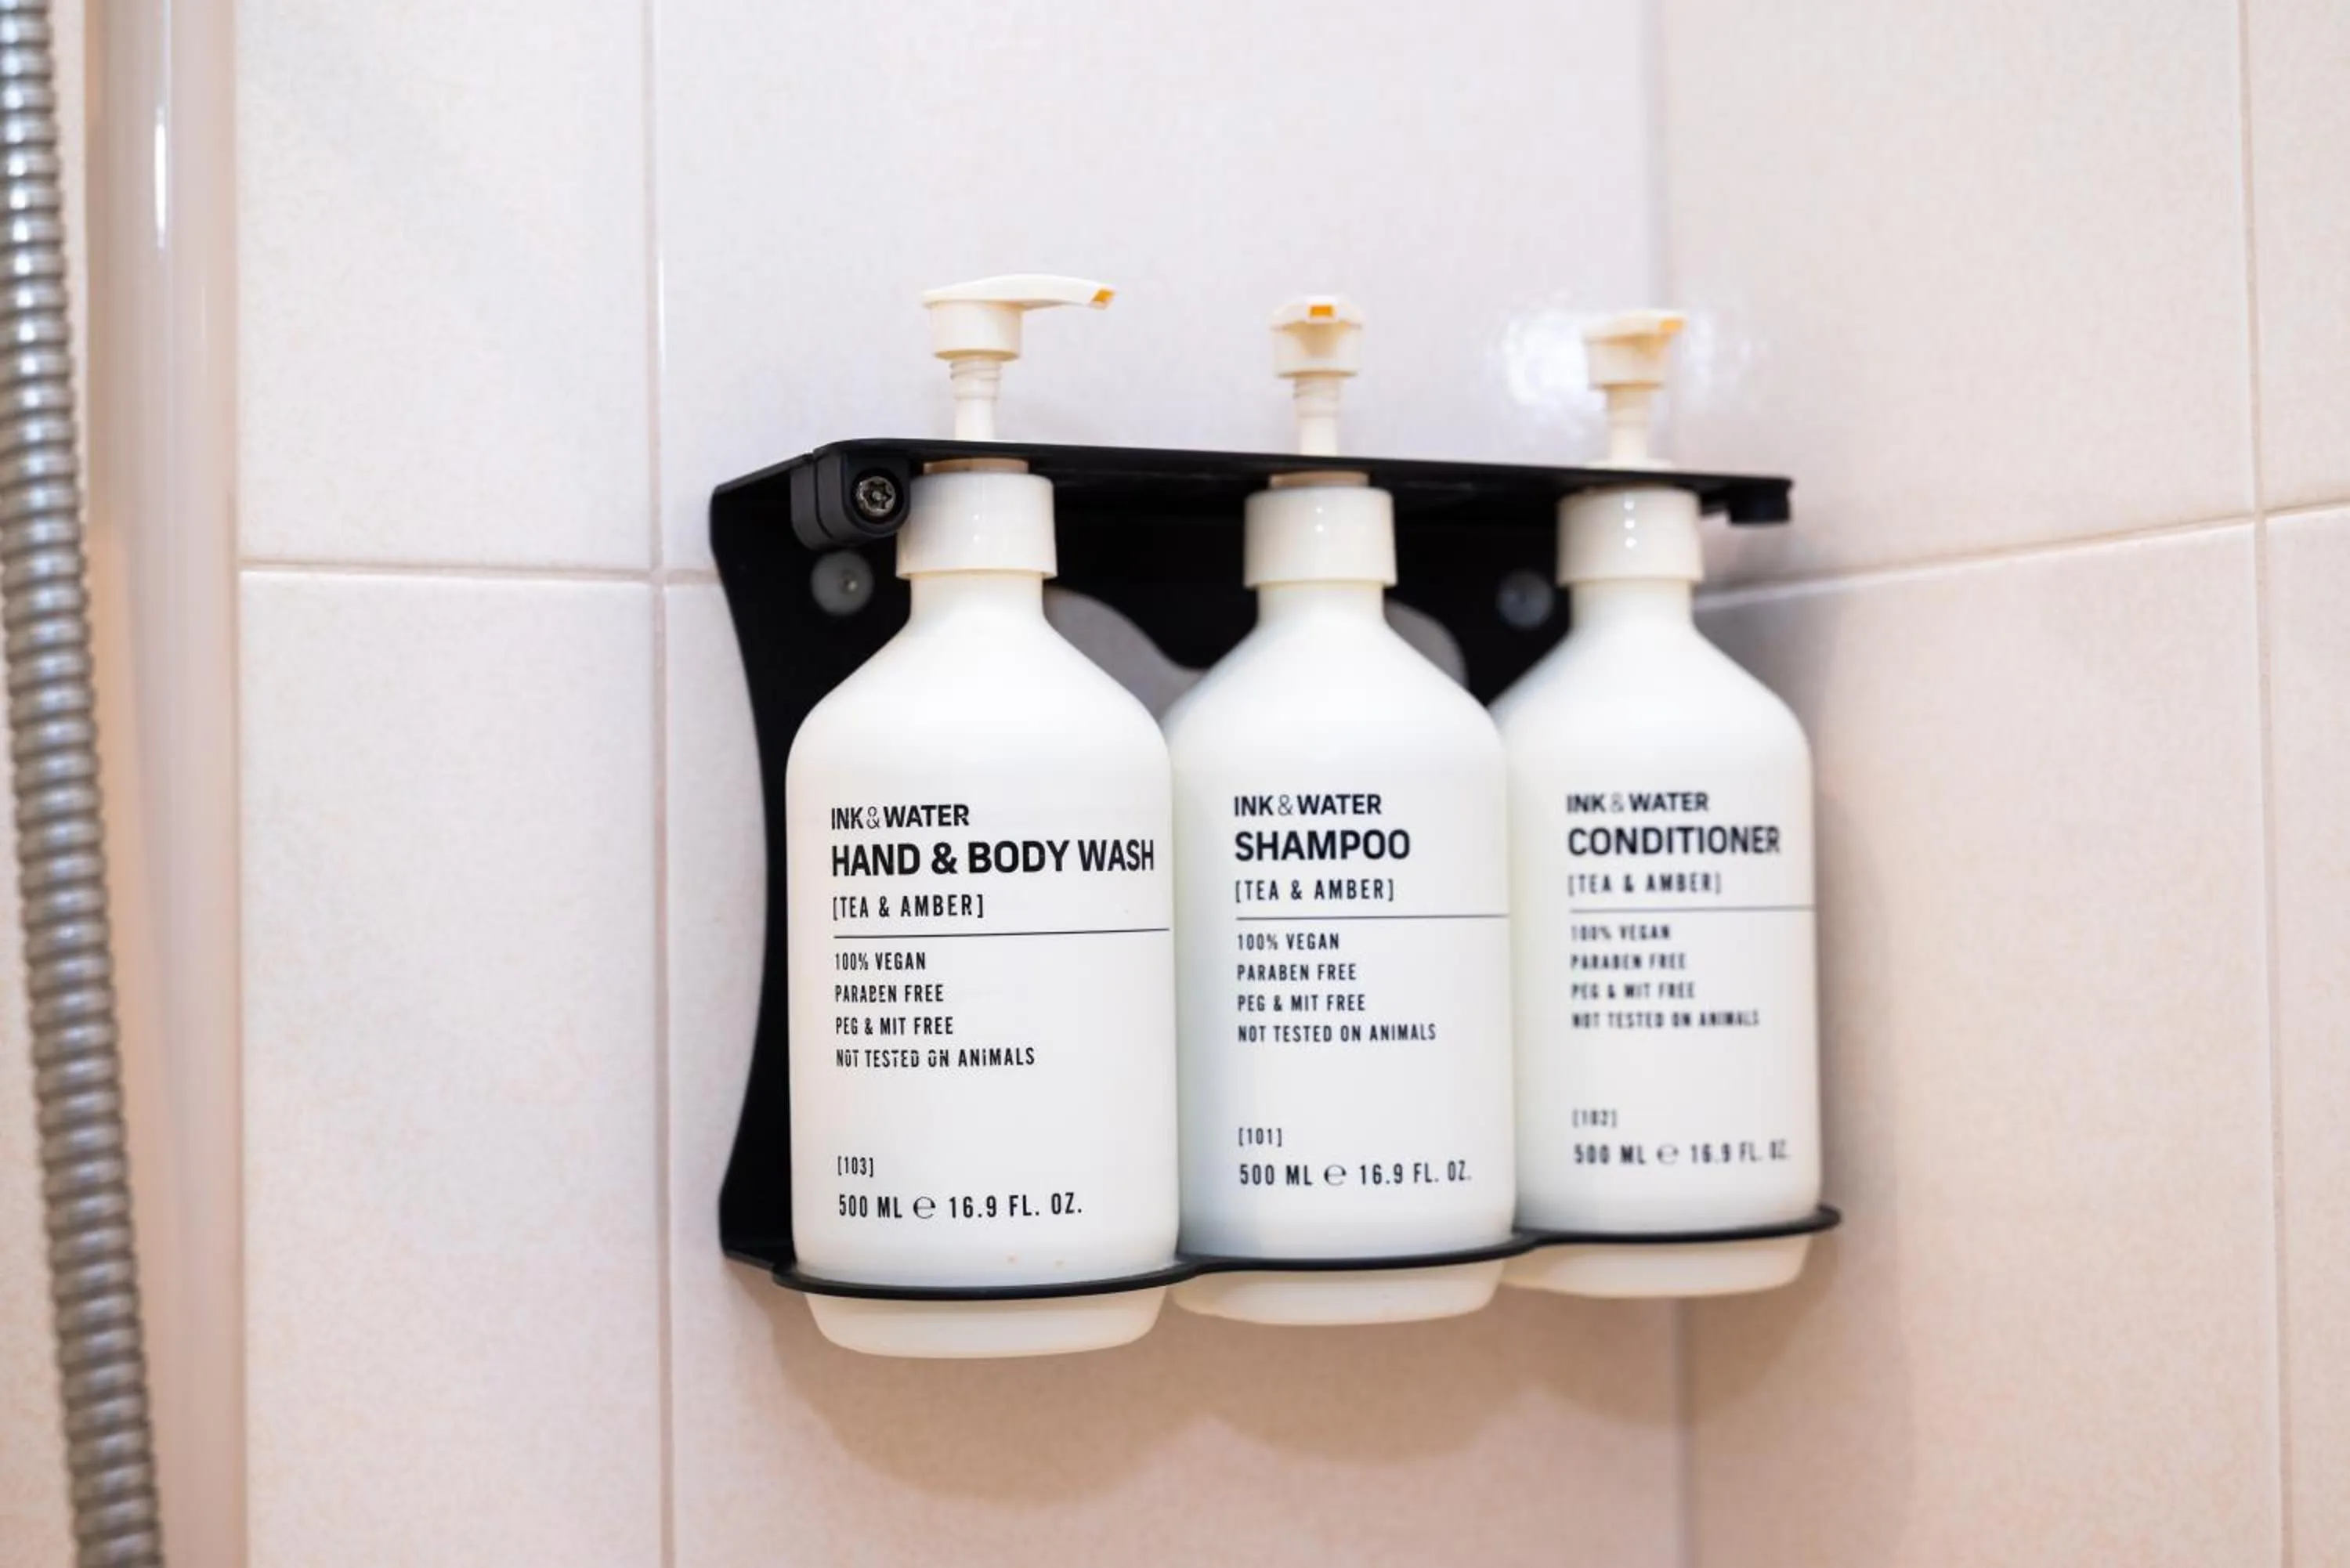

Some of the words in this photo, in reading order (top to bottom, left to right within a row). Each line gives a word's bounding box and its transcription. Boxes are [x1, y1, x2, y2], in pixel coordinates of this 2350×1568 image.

[1234, 793, 1382, 817] INK&WATER
[1566, 791, 1709, 814] INK&WATER
[831, 804, 970, 830] INK&WATER
[1235, 829, 1411, 862] SHAMPOO
[1567, 824, 1781, 857] CONDITIONER
[831, 843, 920, 877] HAND
[931, 841, 958, 875] &
[967, 839, 1070, 874] BODY
[1077, 839, 1155, 872] WASH
[1235, 880, 1279, 904] [TEA
[1290, 879, 1303, 901] &
[1314, 878, 1394, 902] AMBER]
[1567, 873, 1613, 898] [TEA
[1623, 873, 1635, 894] &
[1645, 872, 1721, 894] AMBER]
[833, 895, 870, 922] [TEA
[878, 895, 891, 918] &
[900, 894, 984, 919] AMBER]
[1237, 933, 1278, 952] 100%
[1285, 932, 1340, 951] VEGAN
[1571, 924, 1613, 942] 100%
[1619, 923, 1671, 941] VEGAN
[835, 952, 869, 971] 100%
[874, 952, 926, 971] VEGAN
[1237, 963, 1310, 981] PARABEN
[1317, 963, 1357, 981] FREE
[1570, 953, 1643, 970] PARABEN
[1648, 952, 1686, 970] FREE
[834, 985, 897, 1003] PARABEN
[904, 984, 944, 1003] FREE
[1571, 982, 1600, 1001] PEG
[1607, 983, 1617, 1000] &
[1623, 982, 1650, 999] MIT
[1658, 981, 1695, 999] FREE
[1237, 994, 1266, 1013] PEG
[1273, 994, 1283, 1012] &
[1290, 994, 1318, 1012] MIT
[1326, 993, 1365, 1012] FREE
[835, 1016, 859, 1035] PEG
[864, 1017, 873, 1036] &
[880, 1017, 906, 1035] MIT
[913, 1016, 953, 1035] FREE
[1571, 1011, 1600, 1029] NOT
[1607, 1010, 1665, 1029] TESTED
[1671, 1011, 1692, 1028] ON
[1698, 1010, 1759, 1027] ANIMALS
[1238, 1024, 1267, 1043] NOT
[1273, 1024, 1332, 1043] TESTED
[1340, 1024, 1361, 1042] ON
[1368, 1023, 1436, 1042] ANIMALS
[836, 1049, 859, 1068] NOT
[864, 1049, 920, 1068] TESTED
[927, 1049, 949, 1068] ON
[957, 1046, 1035, 1068] ANIMALS
[1238, 1126, 1282, 1148] [101]
[1573, 1143, 1611, 1165] 500
[1620, 1144, 1646, 1165] ML
[837, 1155, 874, 1179] [103]
[1239, 1163, 1275, 1186] 500
[1285, 1165, 1313, 1187] ML
[1359, 1162, 1404, 1186] 16.9
[1413, 1162, 1439, 1183] FL.
[1447, 1158, 1471, 1183] OZ.
[839, 1194, 868, 1218] 500
[877, 1196, 903, 1219] ML
[949, 1194, 997, 1219] 16.9
[1008, 1194, 1039, 1217] FL.
[1050, 1191, 1083, 1216] OZ.
